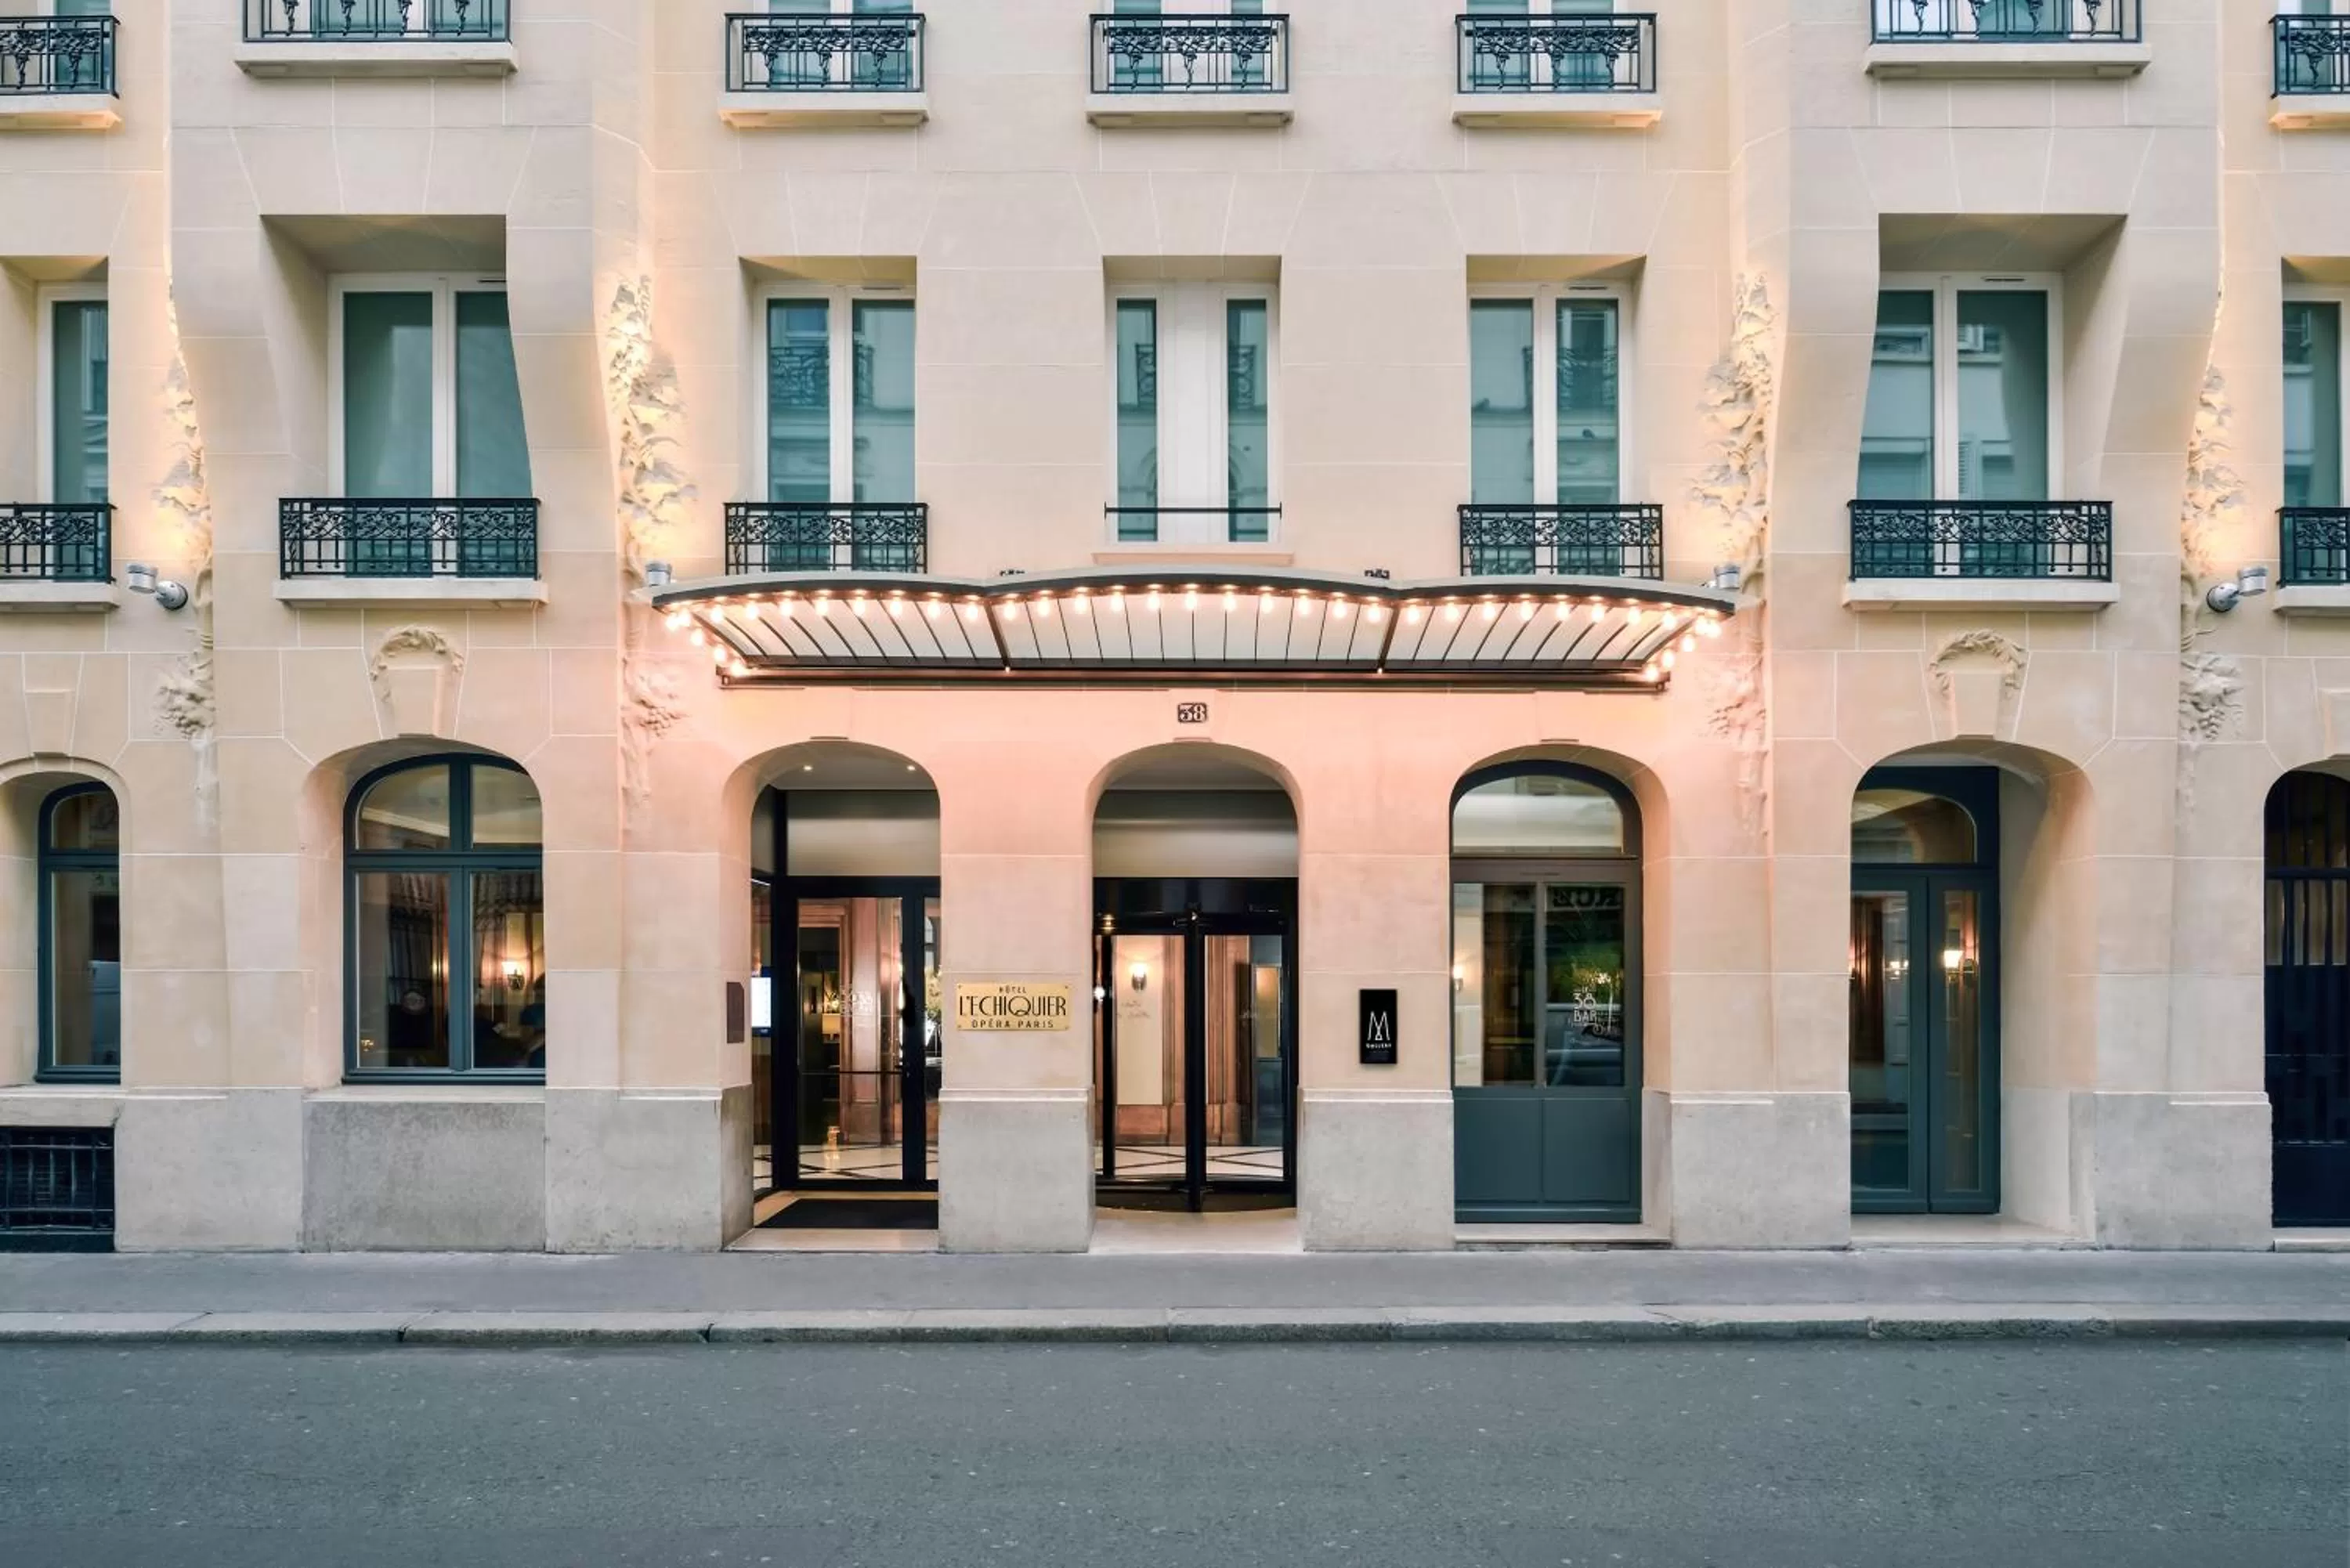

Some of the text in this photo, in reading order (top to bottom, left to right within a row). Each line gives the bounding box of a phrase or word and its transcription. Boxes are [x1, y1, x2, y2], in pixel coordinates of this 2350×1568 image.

[1180, 704, 1206, 721] 38
[1573, 992, 1596, 1010] 38
[971, 1018, 1010, 1028] OPÉRA
[1574, 1010, 1597, 1022] BAR
